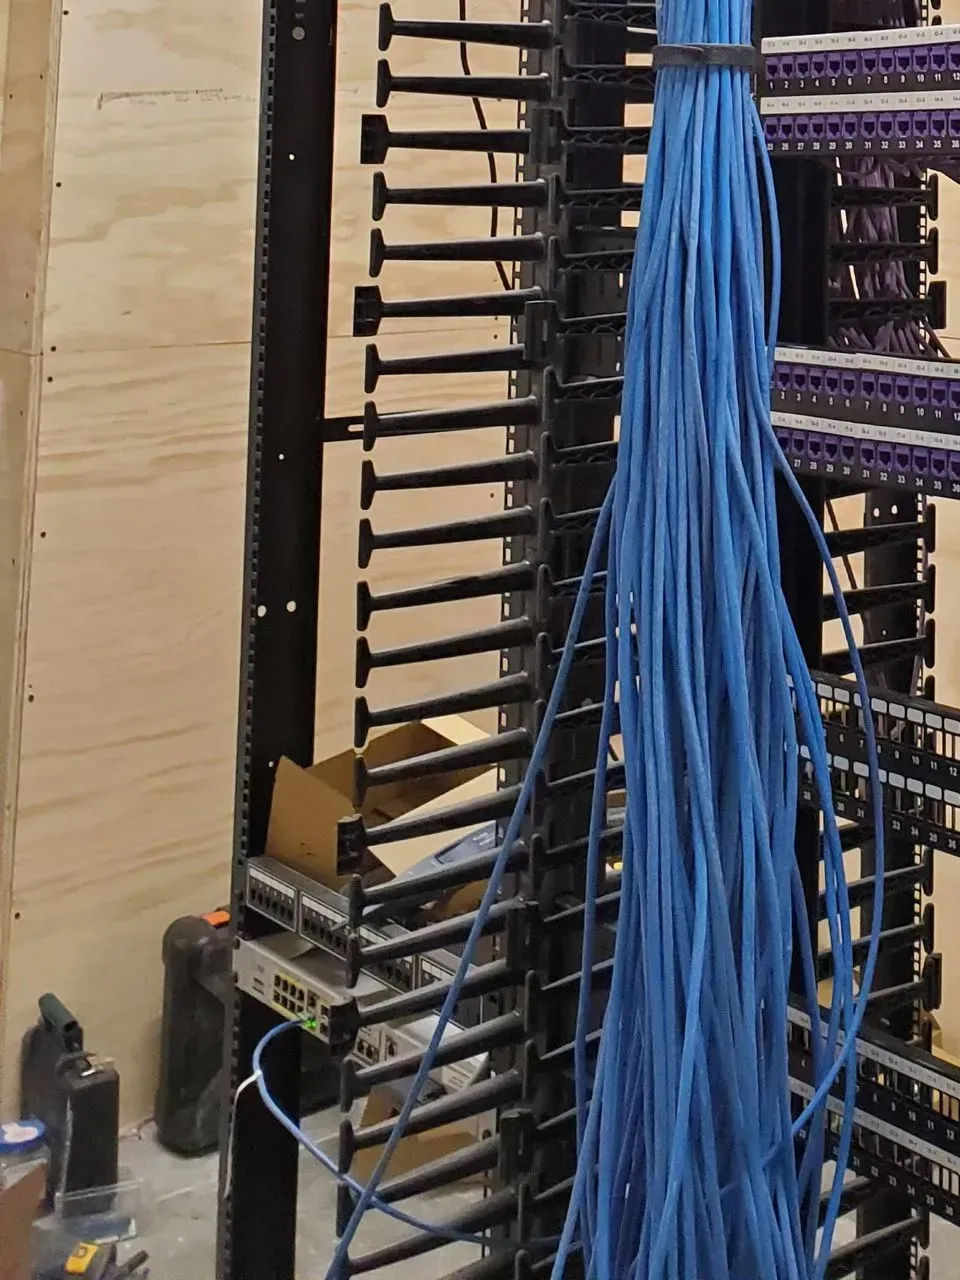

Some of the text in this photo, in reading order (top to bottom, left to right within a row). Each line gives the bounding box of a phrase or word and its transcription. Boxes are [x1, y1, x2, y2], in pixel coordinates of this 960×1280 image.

[916, 73, 925, 83] 10
[934, 73, 942, 82] 11
[952, 72, 960, 81] 12
[916, 407, 925, 417] 10
[934, 409, 942, 419] 11
[948, 766, 958, 777] 12
